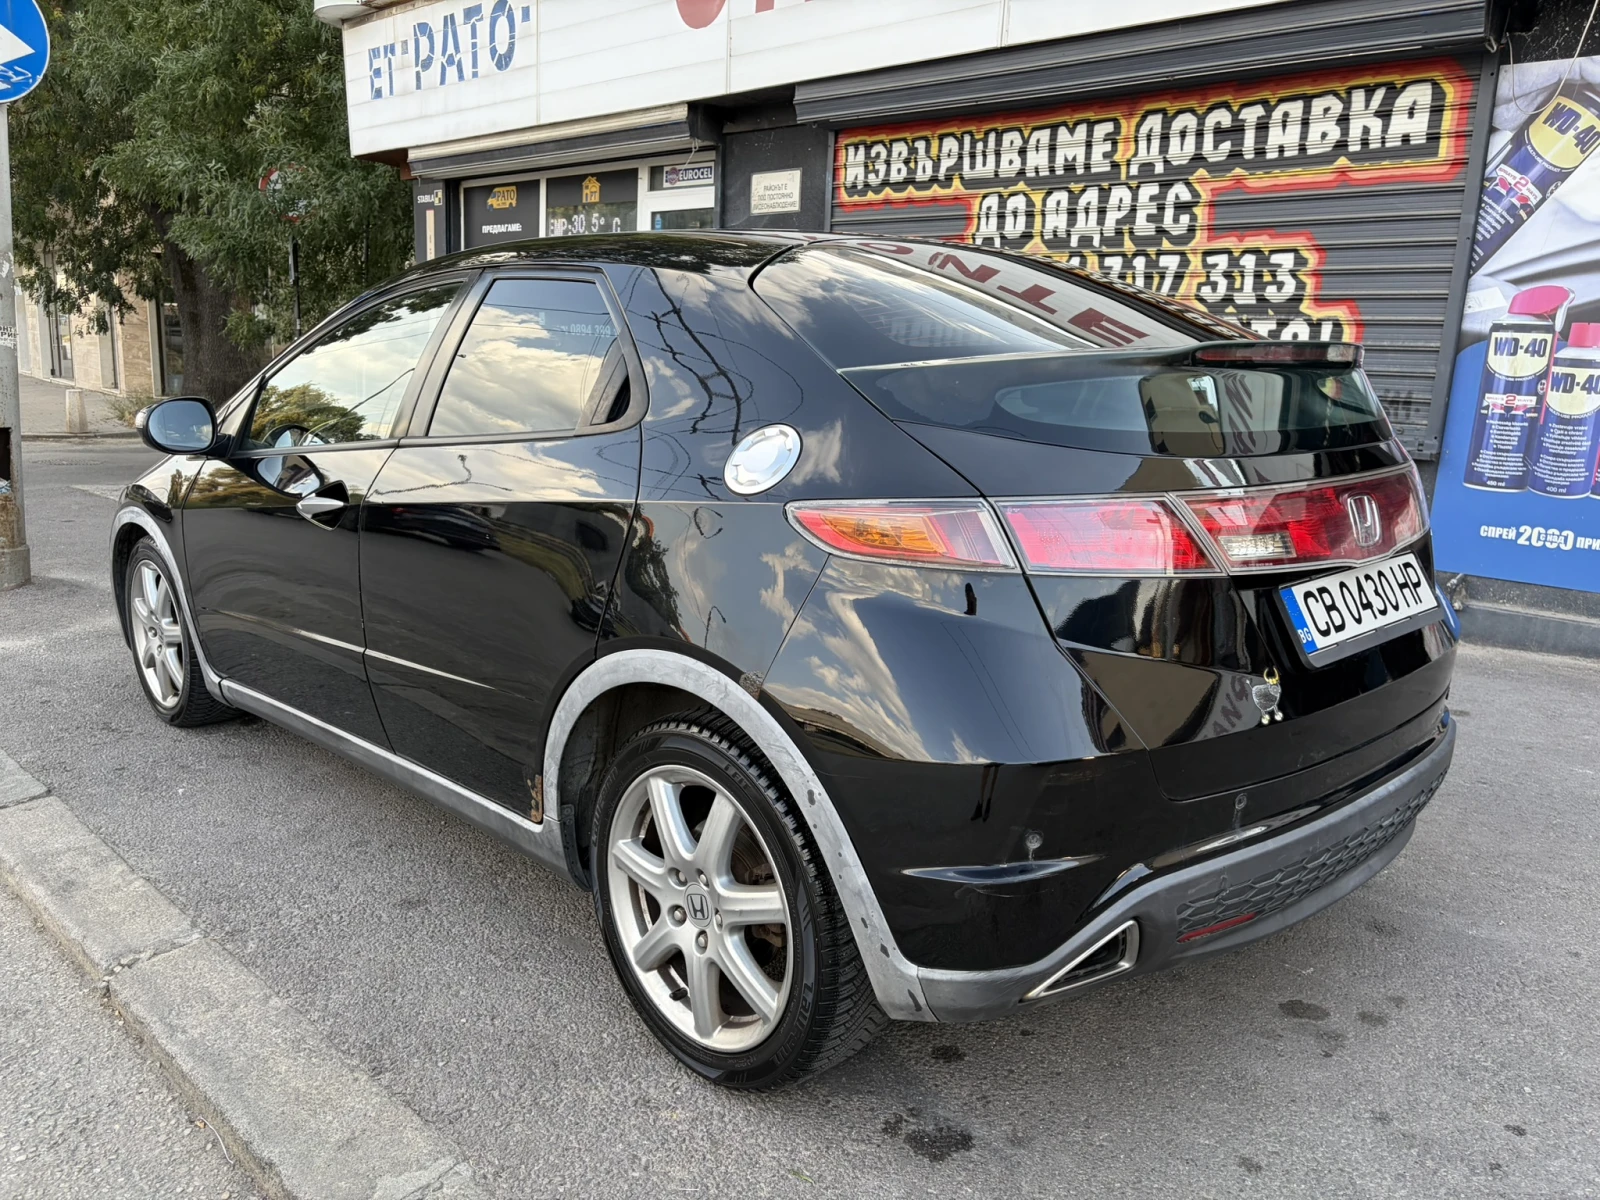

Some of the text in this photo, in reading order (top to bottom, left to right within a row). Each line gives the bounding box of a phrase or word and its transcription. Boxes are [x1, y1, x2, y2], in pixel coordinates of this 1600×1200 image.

[846, 82, 1432, 189] ИЗВЪРШВАМЕ ДОСТАВКА
[1542, 102, 1600, 155] WD-40
[679, 168, 712, 181] EUROCEL
[975, 182, 1193, 248] ДО АДРЕС
[1200, 252, 1296, 304] 313
[1494, 337, 1548, 357] WD-40
[1505, 395, 1517, 405] 2
[1480, 525, 1517, 540] СПРЕЙ
[1339, 570, 1399, 625] 0430
[1298, 628, 1312, 644] BG
